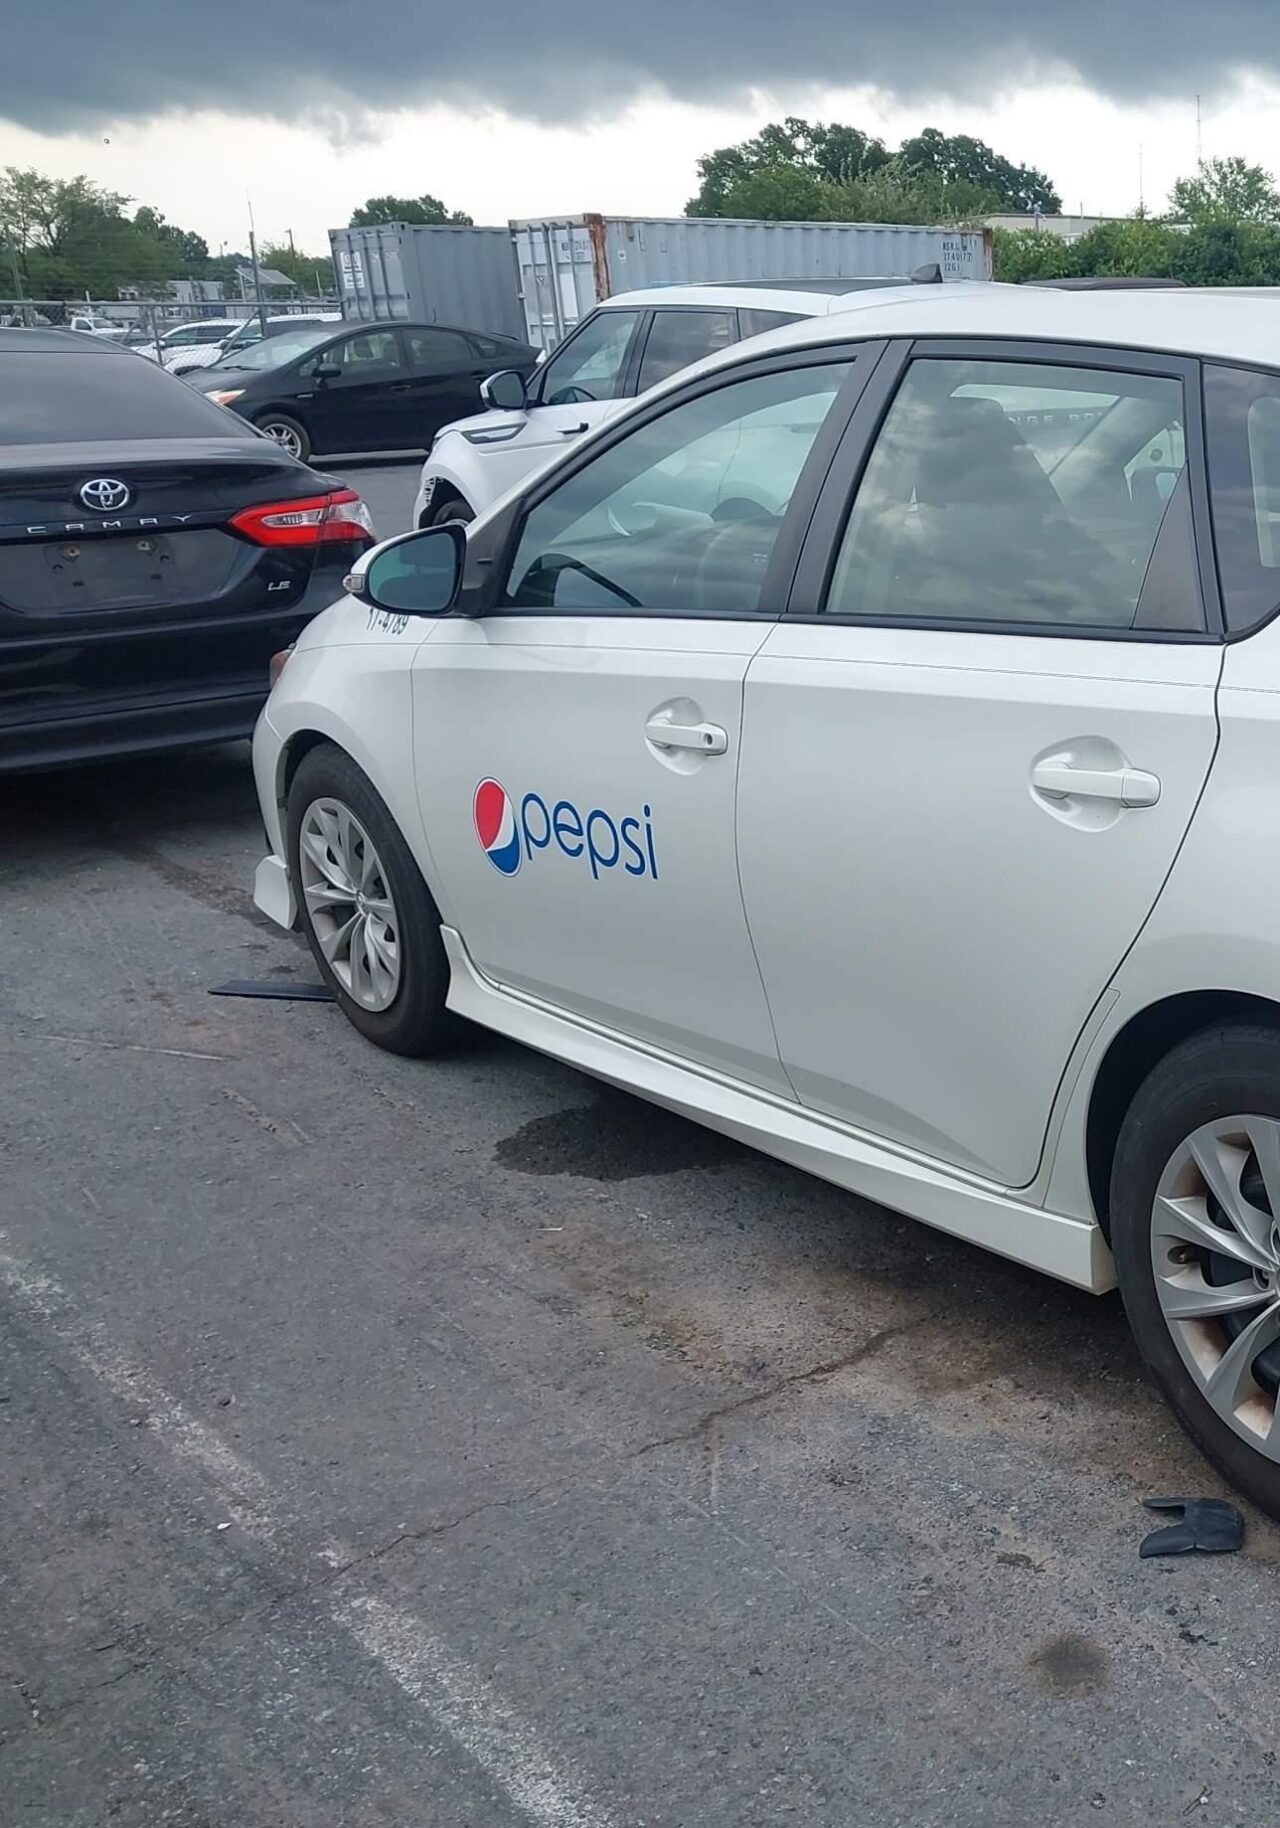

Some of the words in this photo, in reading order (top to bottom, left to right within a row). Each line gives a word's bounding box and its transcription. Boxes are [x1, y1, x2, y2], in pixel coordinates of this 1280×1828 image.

[1007, 414, 1054, 425] NGE
[27, 514, 192, 534] CAMRY
[267, 580, 291, 591] LE
[521, 792, 659, 880] pepsi
